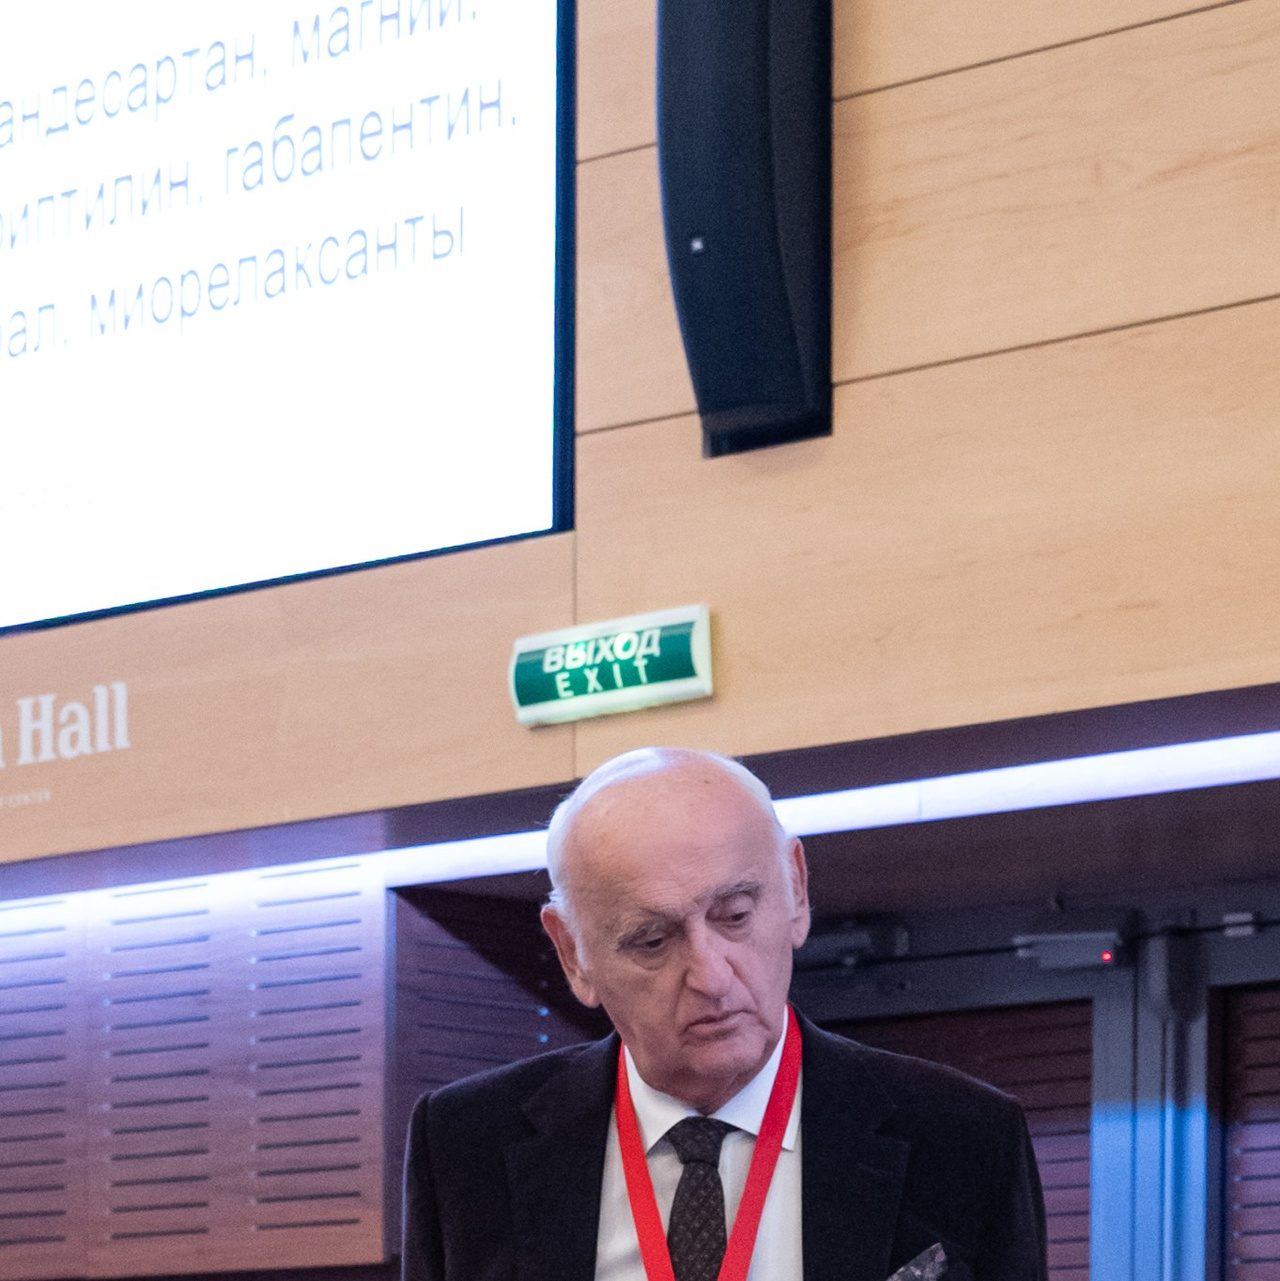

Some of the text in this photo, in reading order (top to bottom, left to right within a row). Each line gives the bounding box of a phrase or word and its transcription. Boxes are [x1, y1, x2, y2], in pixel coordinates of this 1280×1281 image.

[0, 161, 203, 250] иптилин,
[91, 206, 464, 336] миорелаксанты
[542, 629, 661, 674] ВЫХОД
[555, 658, 649, 698] EXIT
[16, 680, 130, 766] Hall
